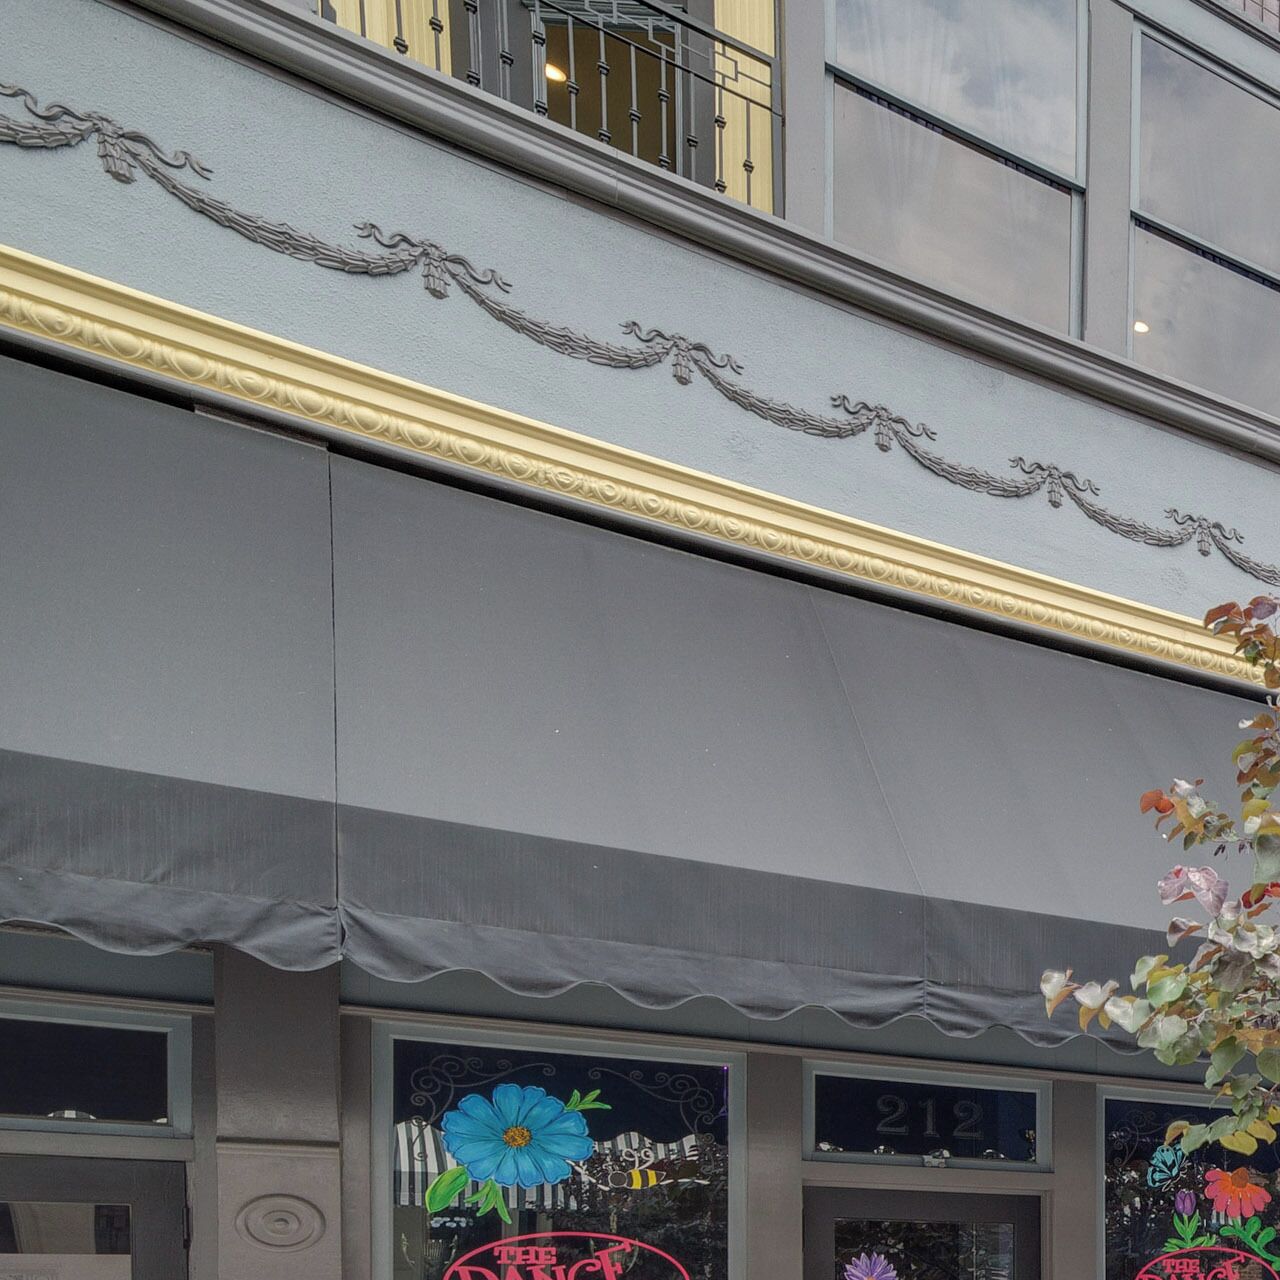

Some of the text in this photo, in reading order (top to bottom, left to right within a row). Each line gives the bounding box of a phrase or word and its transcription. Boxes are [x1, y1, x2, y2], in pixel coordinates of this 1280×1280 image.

[876, 1094, 984, 1140] 212
[493, 1246, 557, 1265] THE
[1162, 1258, 1200, 1273] THE
